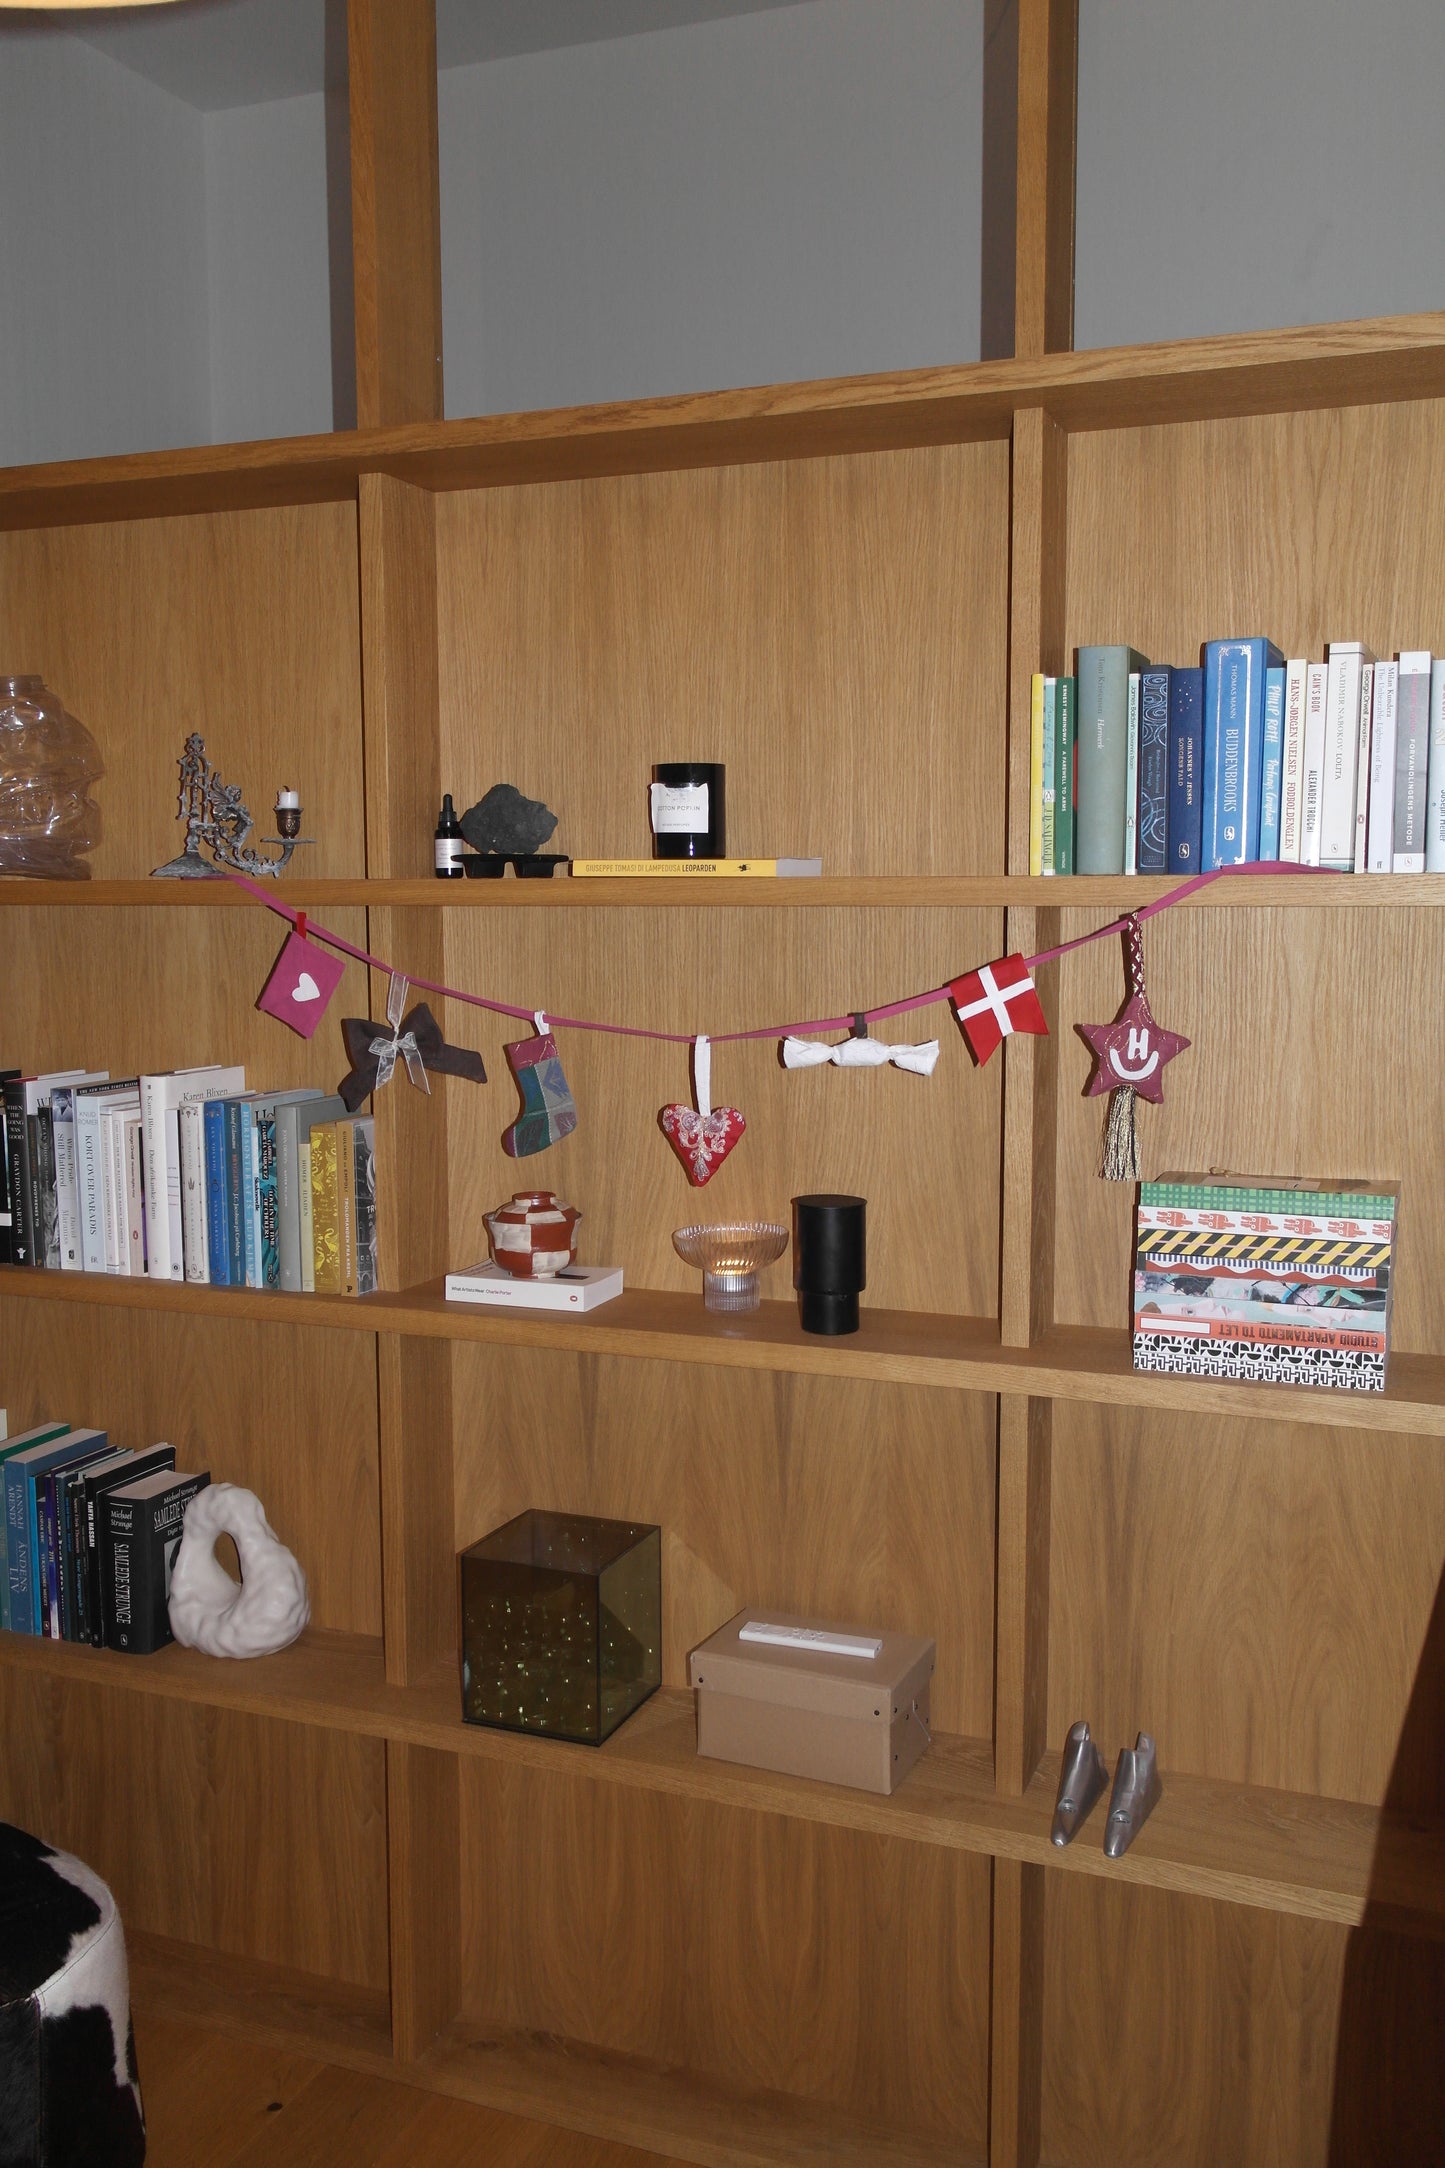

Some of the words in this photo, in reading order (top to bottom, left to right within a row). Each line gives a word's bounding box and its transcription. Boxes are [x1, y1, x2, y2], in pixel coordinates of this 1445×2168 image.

[1230, 664, 1238, 695] THOMAS
[1311, 673, 1322, 694] CAIN'S
[1337, 661, 1347, 706] VLADIMIR
[1362, 669, 1372, 694] George
[1378, 666, 1386, 681] The
[1387, 666, 1396, 688] Milan
[1129, 685, 1137, 706] James
[1267, 684, 1281, 714] PHILIP
[1289, 678, 1300, 738] HANS-JØRGEN
[1310, 696, 1321, 713] BOOK
[1362, 695, 1371, 715] Orwell
[1376, 682, 1385, 720] Unbearable
[1386, 688, 1395, 718] Kundera
[1266, 718, 1280, 743] ROTH
[1336, 707, 1346, 750] NABOKOV
[1361, 717, 1369, 734] Animal
[1374, 722, 1384, 754] Lightness
[1223, 728, 1240, 812] BUDDENBROOKS
[1287, 739, 1299, 776] NIELSEN
[1334, 753, 1343, 780] LOLITA
[1307, 769, 1318, 806] ALEXANDER
[1373, 764, 1382, 783] Being
[1406, 738, 1416, 811] FORVANDLINGENS
[1061, 787, 1067, 795] TO
[1263, 792, 1279, 828] Complaint
[1285, 781, 1297, 850] FODBOLDENGLEN
[1305, 806, 1316, 833] TROCCHI
[1044, 824, 1053, 864] SALINGER
[1405, 813, 1413, 846] METODE
[585, 864, 613, 873] GIUSEPPE
[614, 864, 637, 873] TOMASI
[637, 864, 644, 873] DI
[645, 864, 681, 873] LAMPEDUSA
[682, 864, 717, 873] LEOPARDEN
[183, 1091, 205, 1102] Karen
[206, 1088, 229, 1098] Blixen
[57, 1133, 65, 1150] Still
[85, 1134, 94, 1161] KORT
[242, 1111, 252, 1180] HORISONTER
[13, 1153, 22, 1197] GRAYDON
[58, 1151, 67, 1187] Mattered
[86, 1163, 95, 1192] OVER
[150, 1165, 158, 1200] afrikanske
[15, 1199, 23, 1235] CARTER
[87, 1193, 98, 1235] PARADIS
[246, 1218, 254, 1240] RUD
[234, 1232, 242, 1257] Carlsberg
[1218, 1324, 1240, 1337] LET
[1241, 1326, 1256, 1339] TO
[1258, 1328, 1337, 1345] APARTAMENTO
[1339, 1334, 1379, 1348] STUDIO
[8, 1485, 17, 1528] ARENDT
[16, 1484, 25, 1530] HANNAH
[163, 1488, 182, 1505] Michael
[110, 1509, 133, 1520] Michael
[110, 1519, 133, 1532] Strunge
[153, 1501, 181, 1530] SAMLEDE
[88, 1522, 96, 1548] HASSAN
[18, 1540, 28, 1593] ÅNDENS
[113, 1542, 130, 1585] SAMLEDE
[9, 1567, 20, 1595] LIV
[115, 1585, 131, 1624] STRUNGE
